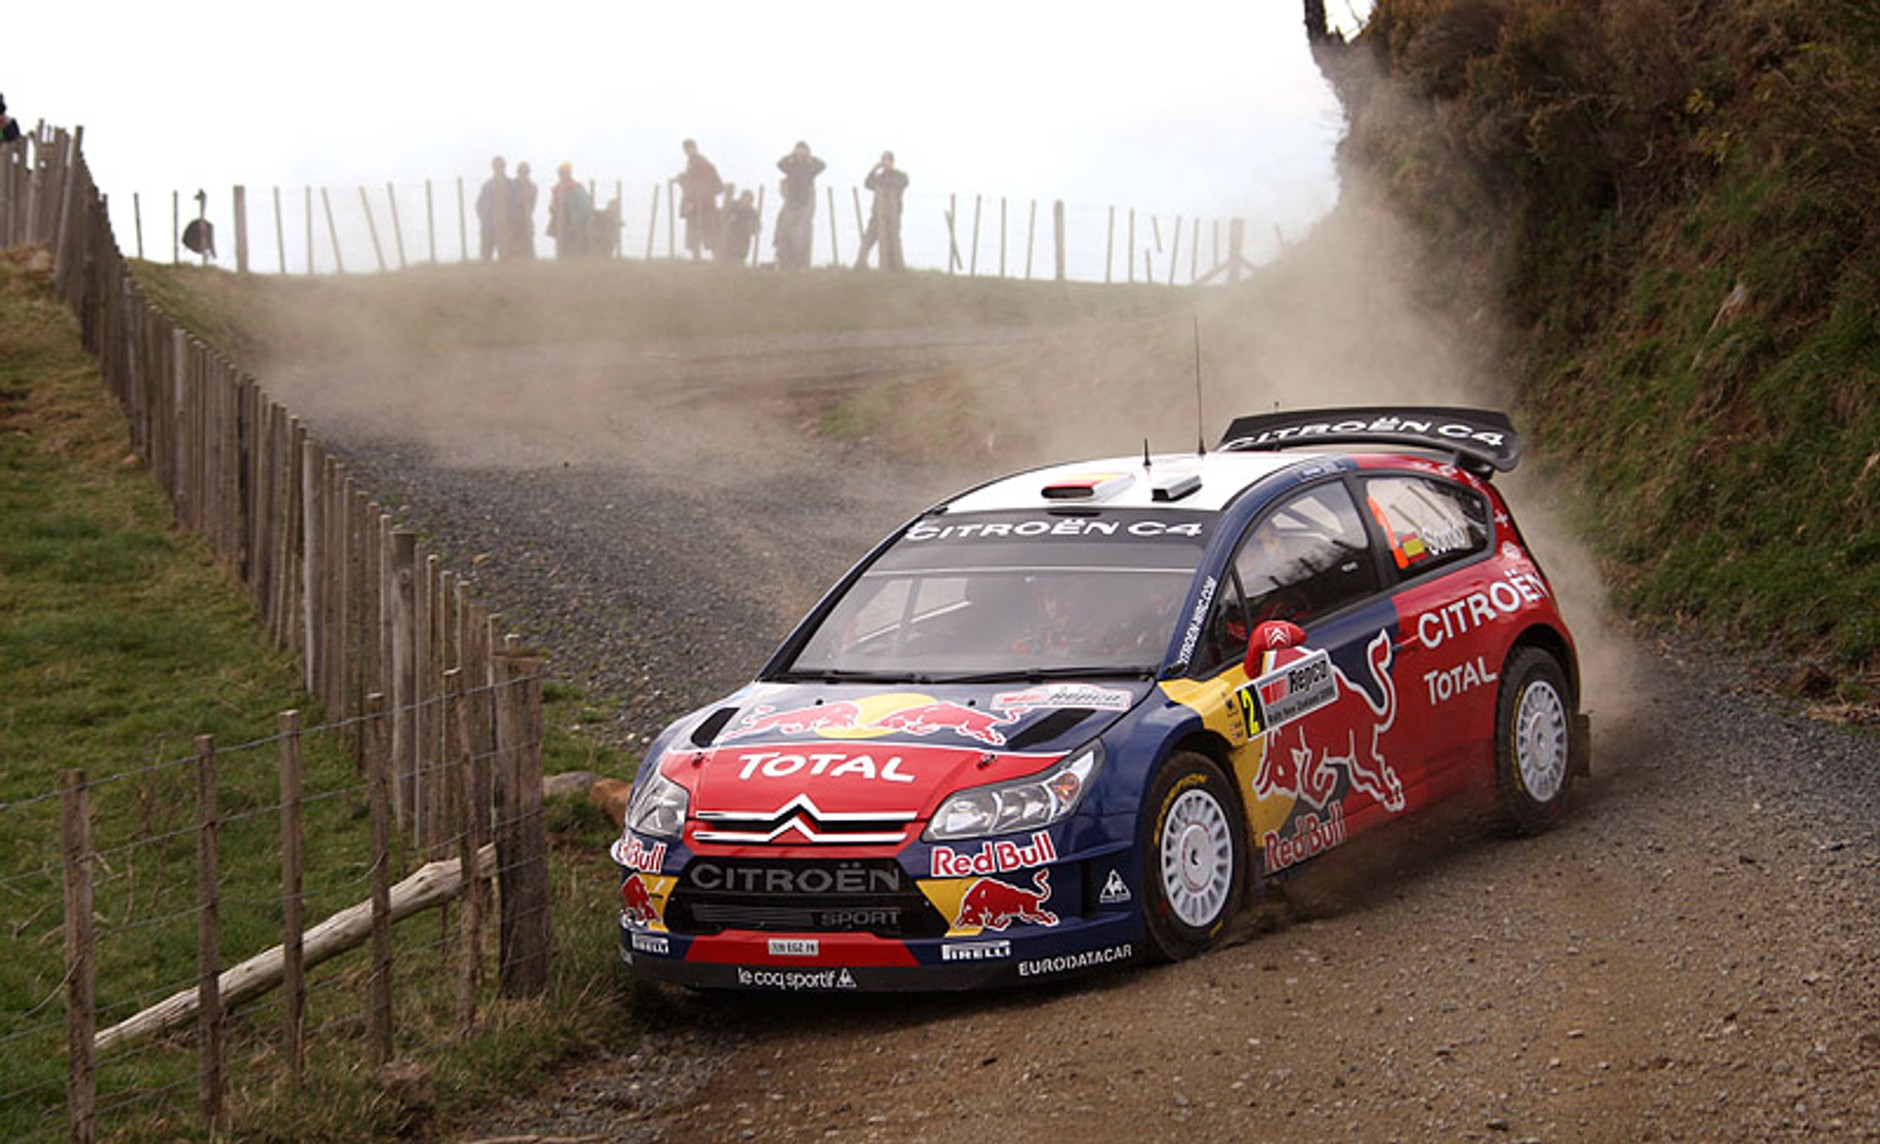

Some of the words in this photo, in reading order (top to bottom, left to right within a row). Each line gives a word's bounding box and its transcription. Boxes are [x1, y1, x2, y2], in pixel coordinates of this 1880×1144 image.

[1219, 416, 1431, 451] CITROËN
[1438, 424, 1503, 446] C4
[905, 517, 1119, 541] CITROËN
[1127, 521, 1203, 538] C4
[1417, 568, 1549, 649] CITROËN
[1424, 656, 1499, 705] TOTAL
[1240, 688, 1260, 735] 2
[737, 752, 915, 783] TOTAL
[1264, 816, 1306, 871] Red
[1304, 800, 1347, 853] Bull
[931, 841, 996, 877] Red
[998, 831, 1057, 872] Bull
[690, 861, 899, 892] CITROËN
[820, 910, 899, 926] SPORT
[942, 939, 1011, 960] PIRELLI
[1018, 944, 1132, 976] EURODATACAR
[738, 967, 752, 985] le
[754, 971, 785, 991] coq
[786, 969, 836, 991] sportif
